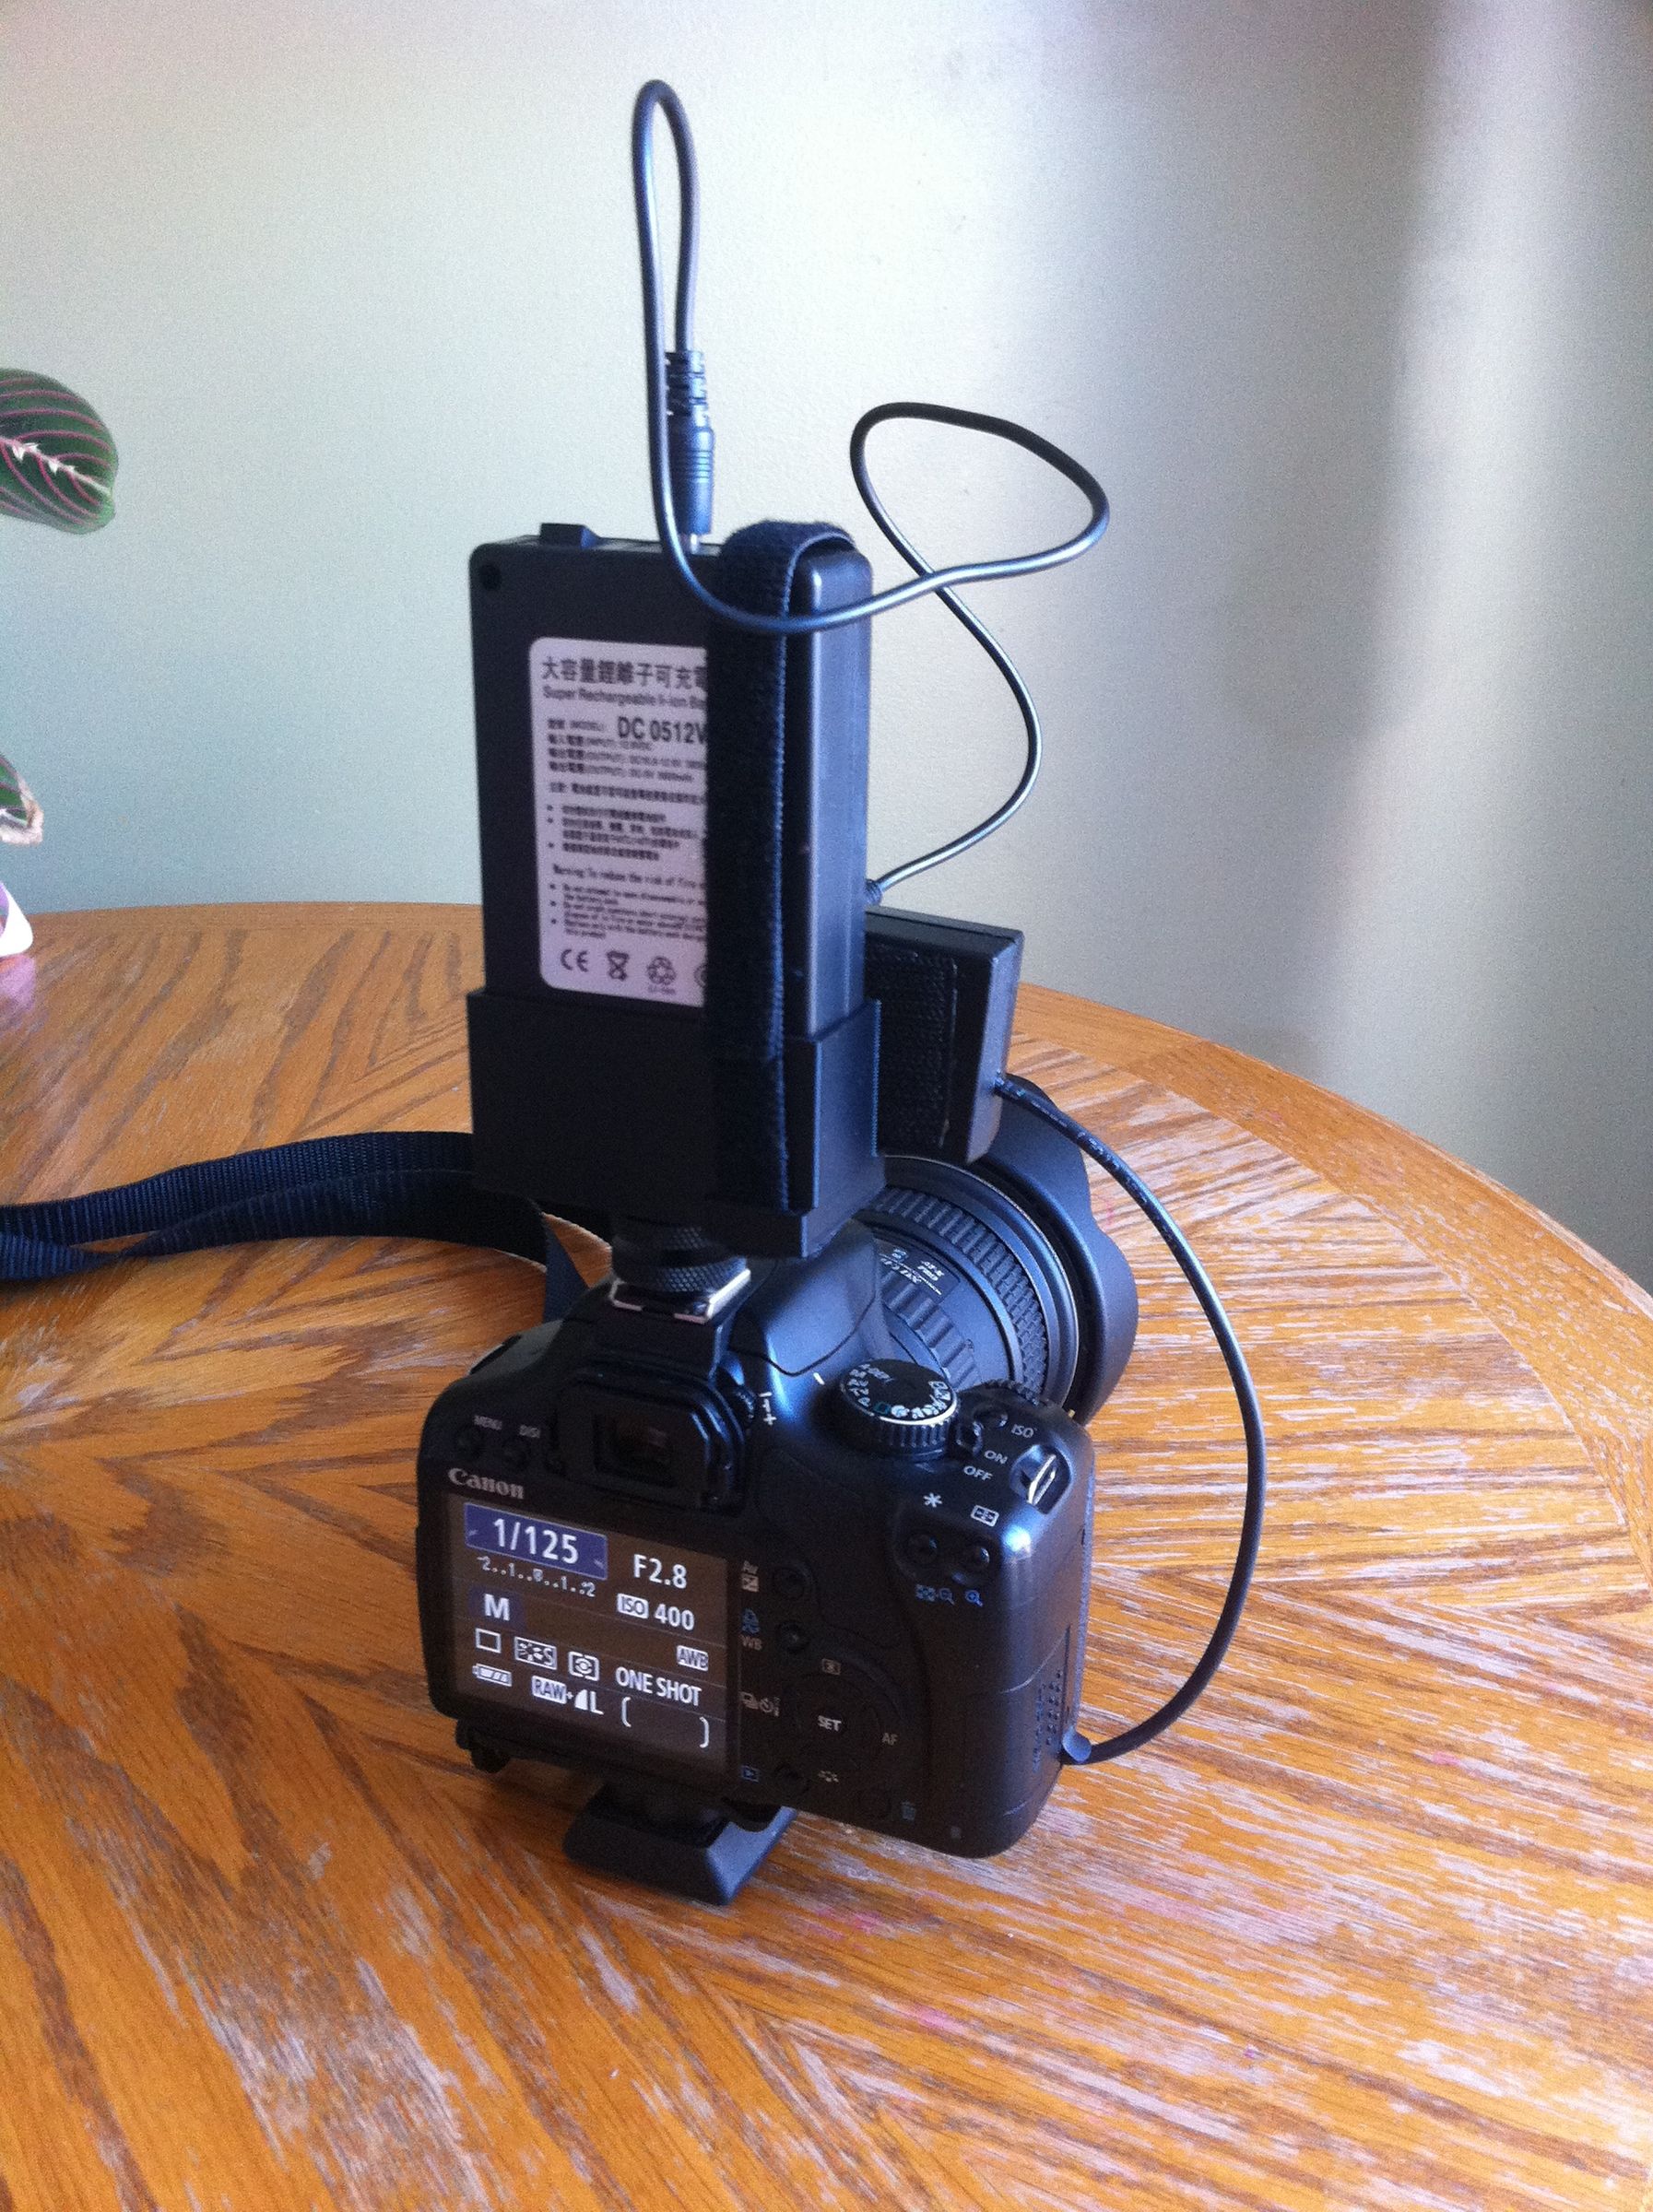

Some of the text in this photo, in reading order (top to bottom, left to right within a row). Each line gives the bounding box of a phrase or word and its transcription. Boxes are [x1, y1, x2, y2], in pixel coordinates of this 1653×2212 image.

[618, 716, 645, 739] DC
[560, 948, 588, 972] CE
[1010, 1424, 1034, 1439] ISO
[984, 1450, 1008, 1465] ON
[447, 1467, 525, 1500] Canon
[963, 1465, 993, 1481] OFF
[493, 1517, 579, 1565] 1/125
[632, 1553, 688, 1589] F2.8
[483, 1593, 511, 1621] M
[619, 1595, 695, 1630] ISO 400
[679, 1647, 707, 1670] AWB
[533, 1677, 565, 1702] RAW
[615, 1665, 703, 1707] ONE SHOT
[818, 1715, 843, 1732] SET
[881, 1732, 898, 1746] AF
